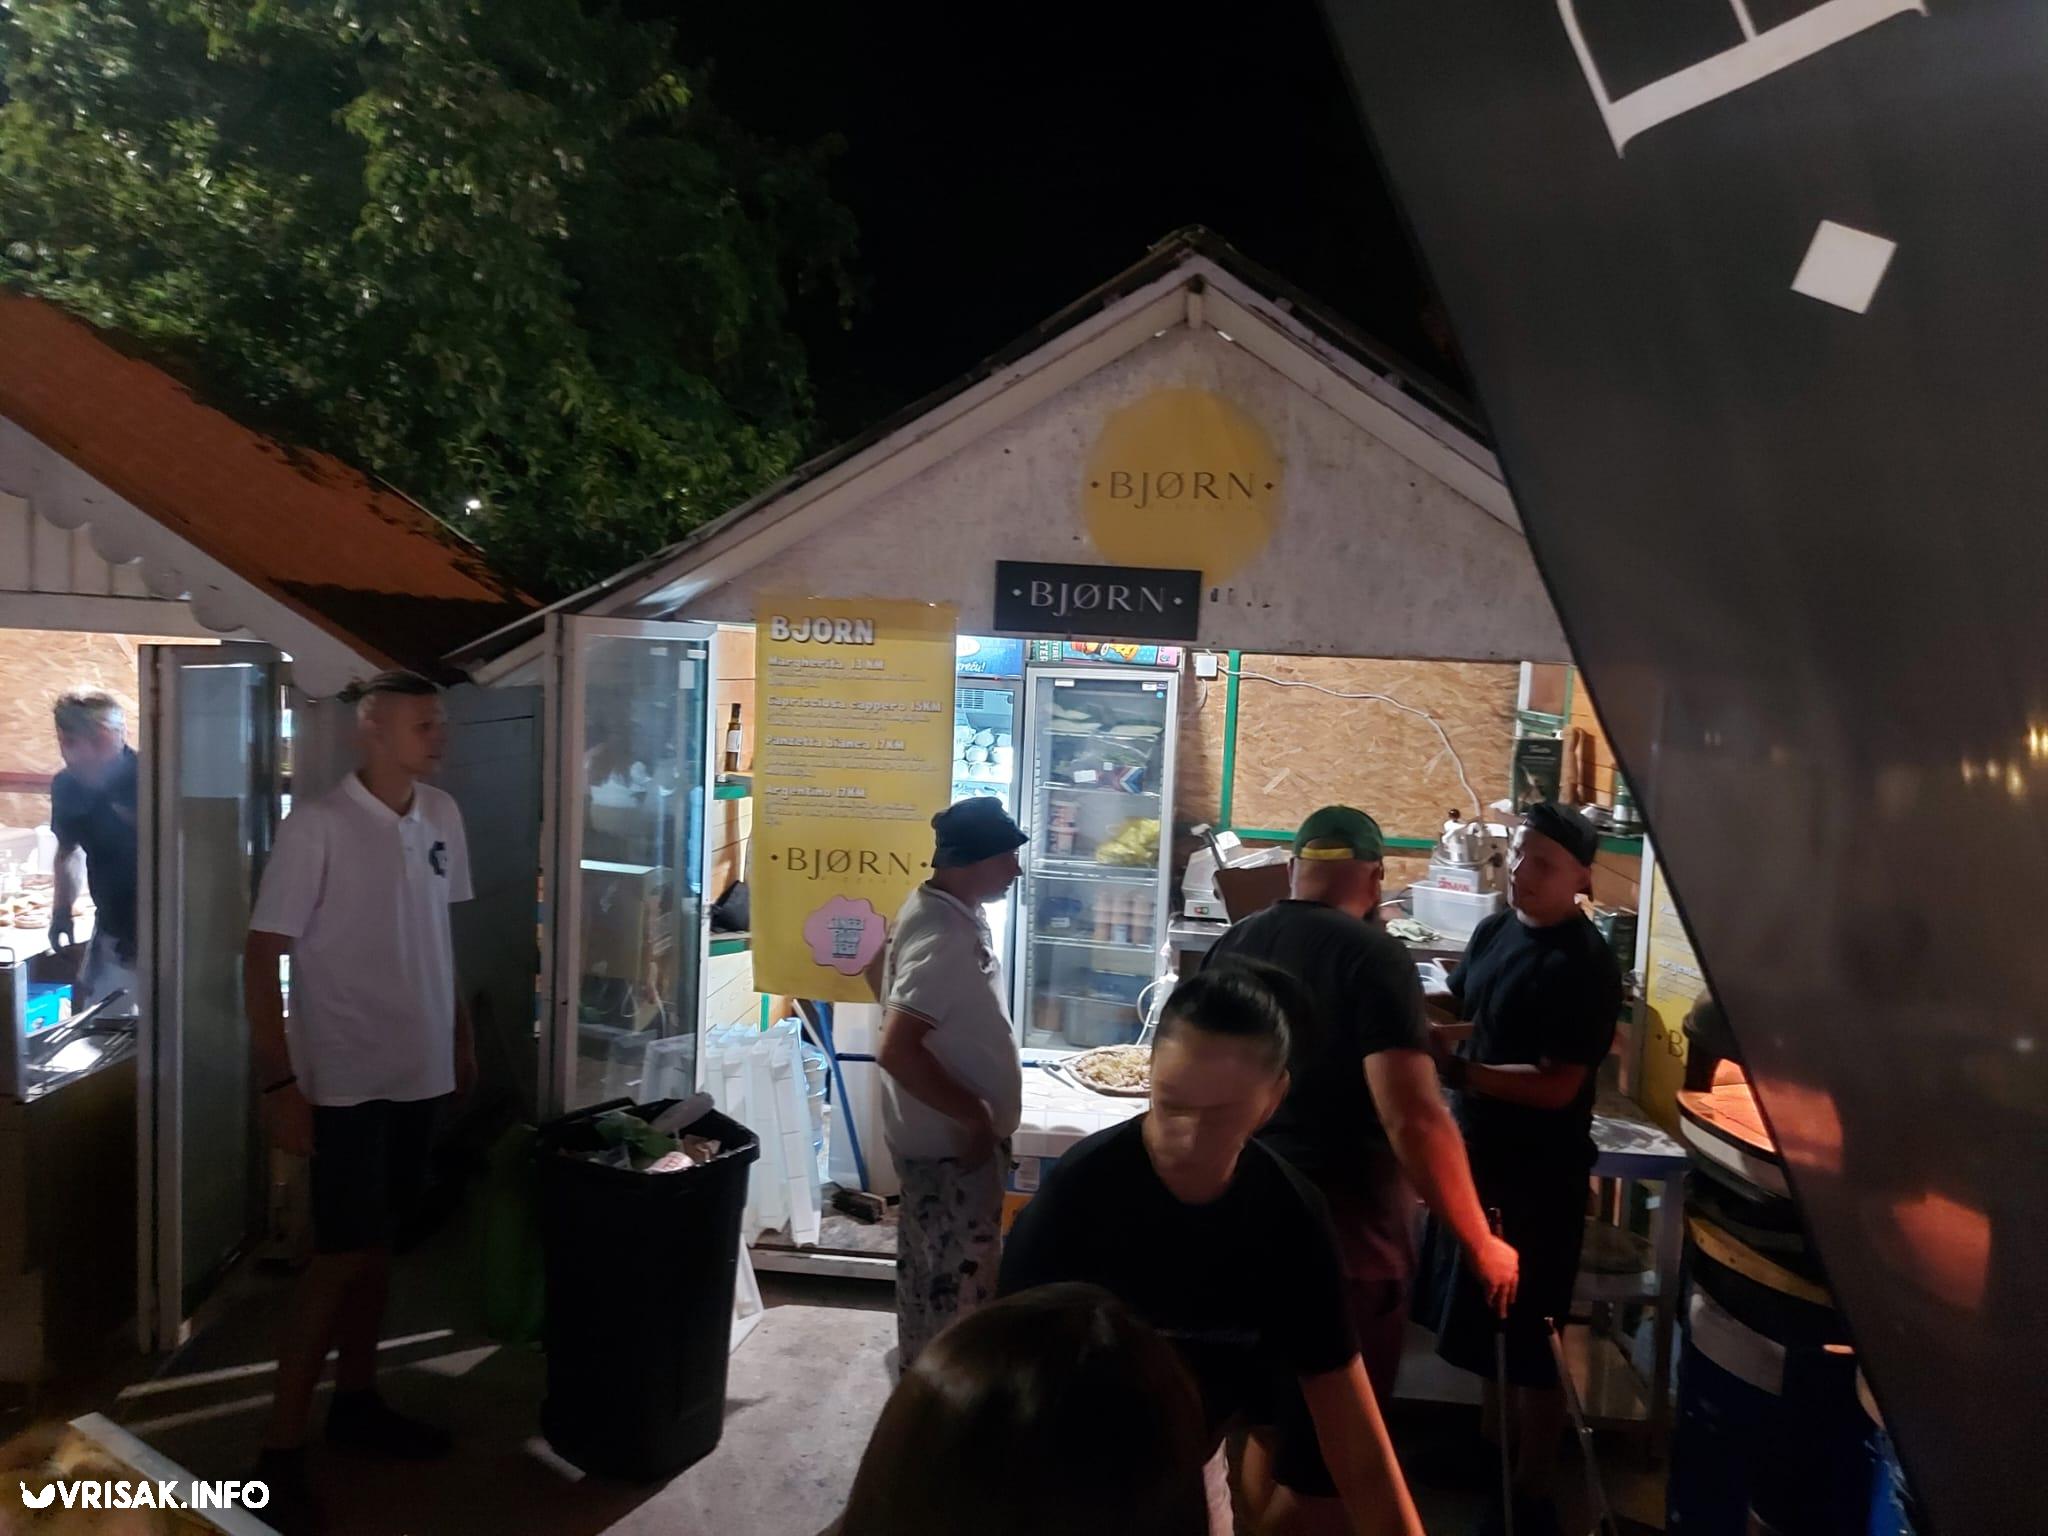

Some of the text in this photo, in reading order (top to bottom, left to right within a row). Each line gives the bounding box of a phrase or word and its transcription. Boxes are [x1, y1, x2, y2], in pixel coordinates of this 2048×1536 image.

[1109, 471, 1254, 509] BJØRN
[1029, 579, 1167, 617] BJØRN
[770, 614, 875, 645] BJORN
[768, 657, 844, 672] Margherita
[786, 847, 912, 880] BJØRN
